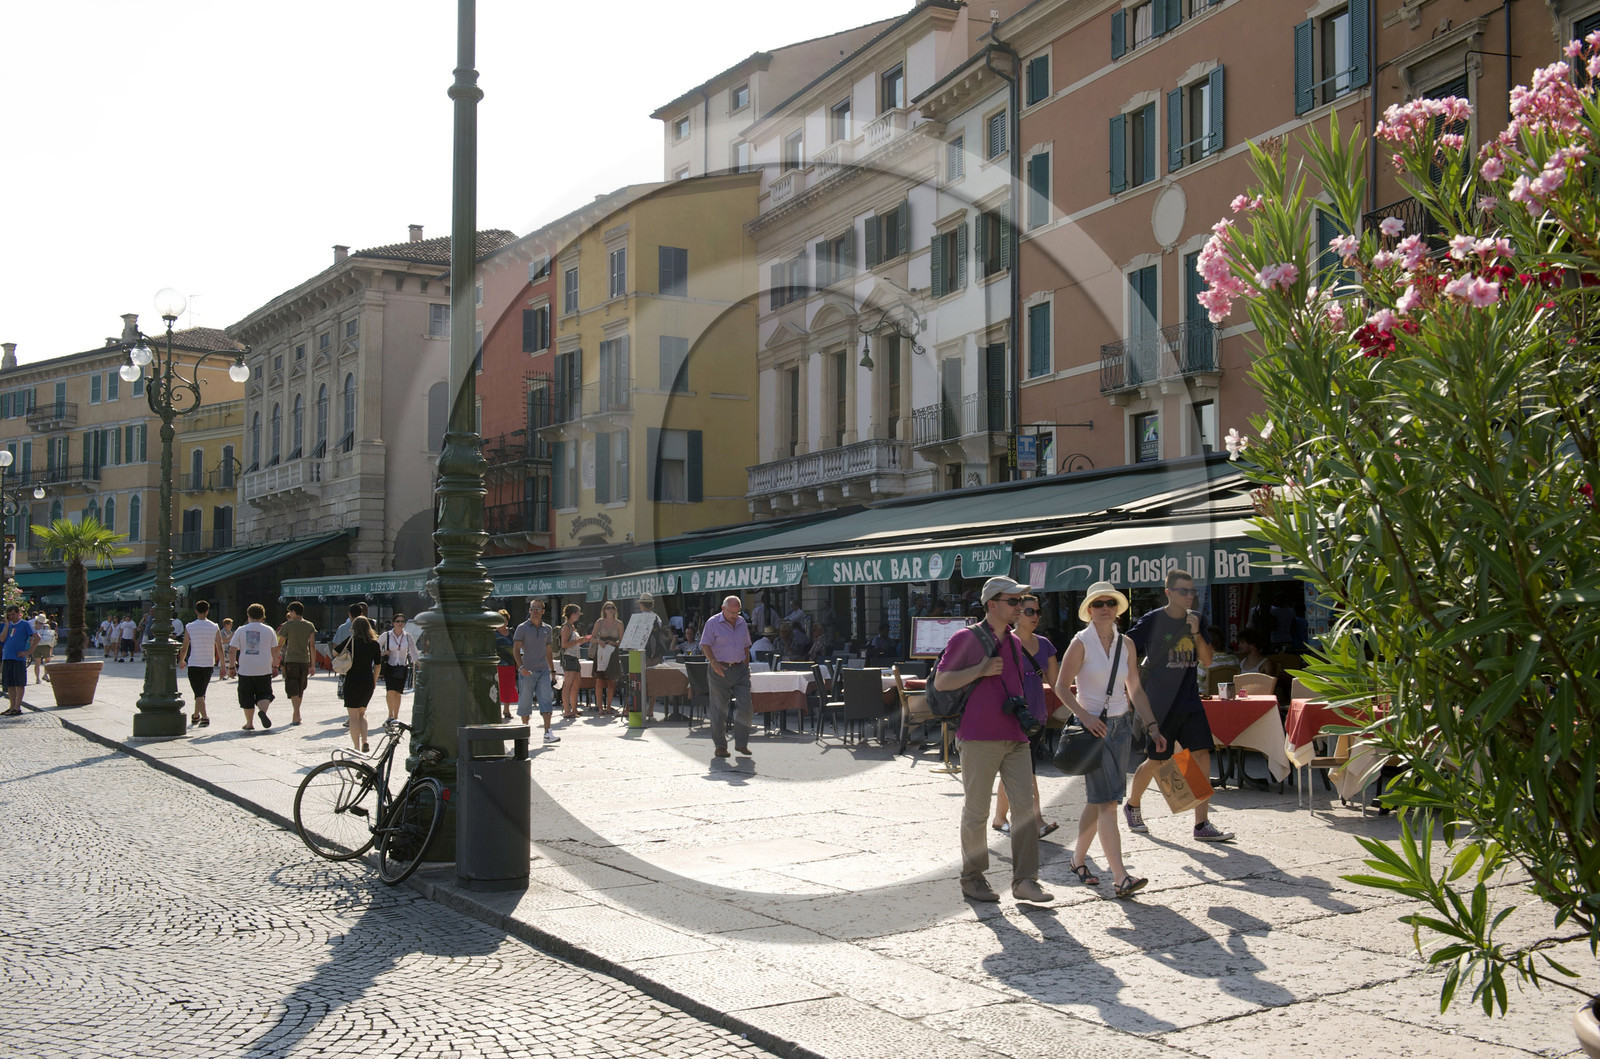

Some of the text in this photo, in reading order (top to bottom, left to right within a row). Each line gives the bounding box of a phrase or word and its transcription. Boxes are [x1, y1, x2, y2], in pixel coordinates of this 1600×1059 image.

[972, 549, 1002, 562] PELLINI
[782, 562, 802, 573] PELLINI
[832, 560, 884, 583] SNACK
[890, 557, 922, 580] BAR
[978, 561, 995, 573] TOP
[1099, 558, 1121, 584] La
[1127, 554, 1179, 584] Costa
[1185, 551, 1206, 580] in
[1214, 549, 1251, 579] Bra
[705, 565, 779, 589] EMANUEL
[786, 572, 797, 583] TOP
[294, 585, 324, 596] RISTORANTE
[328, 584, 343, 593] PIZZA
[350, 583, 362, 593] BAR
[369, 581, 396, 592] LISTON
[399, 580, 408, 590] 12
[620, 576, 666, 597] GELATERIA
